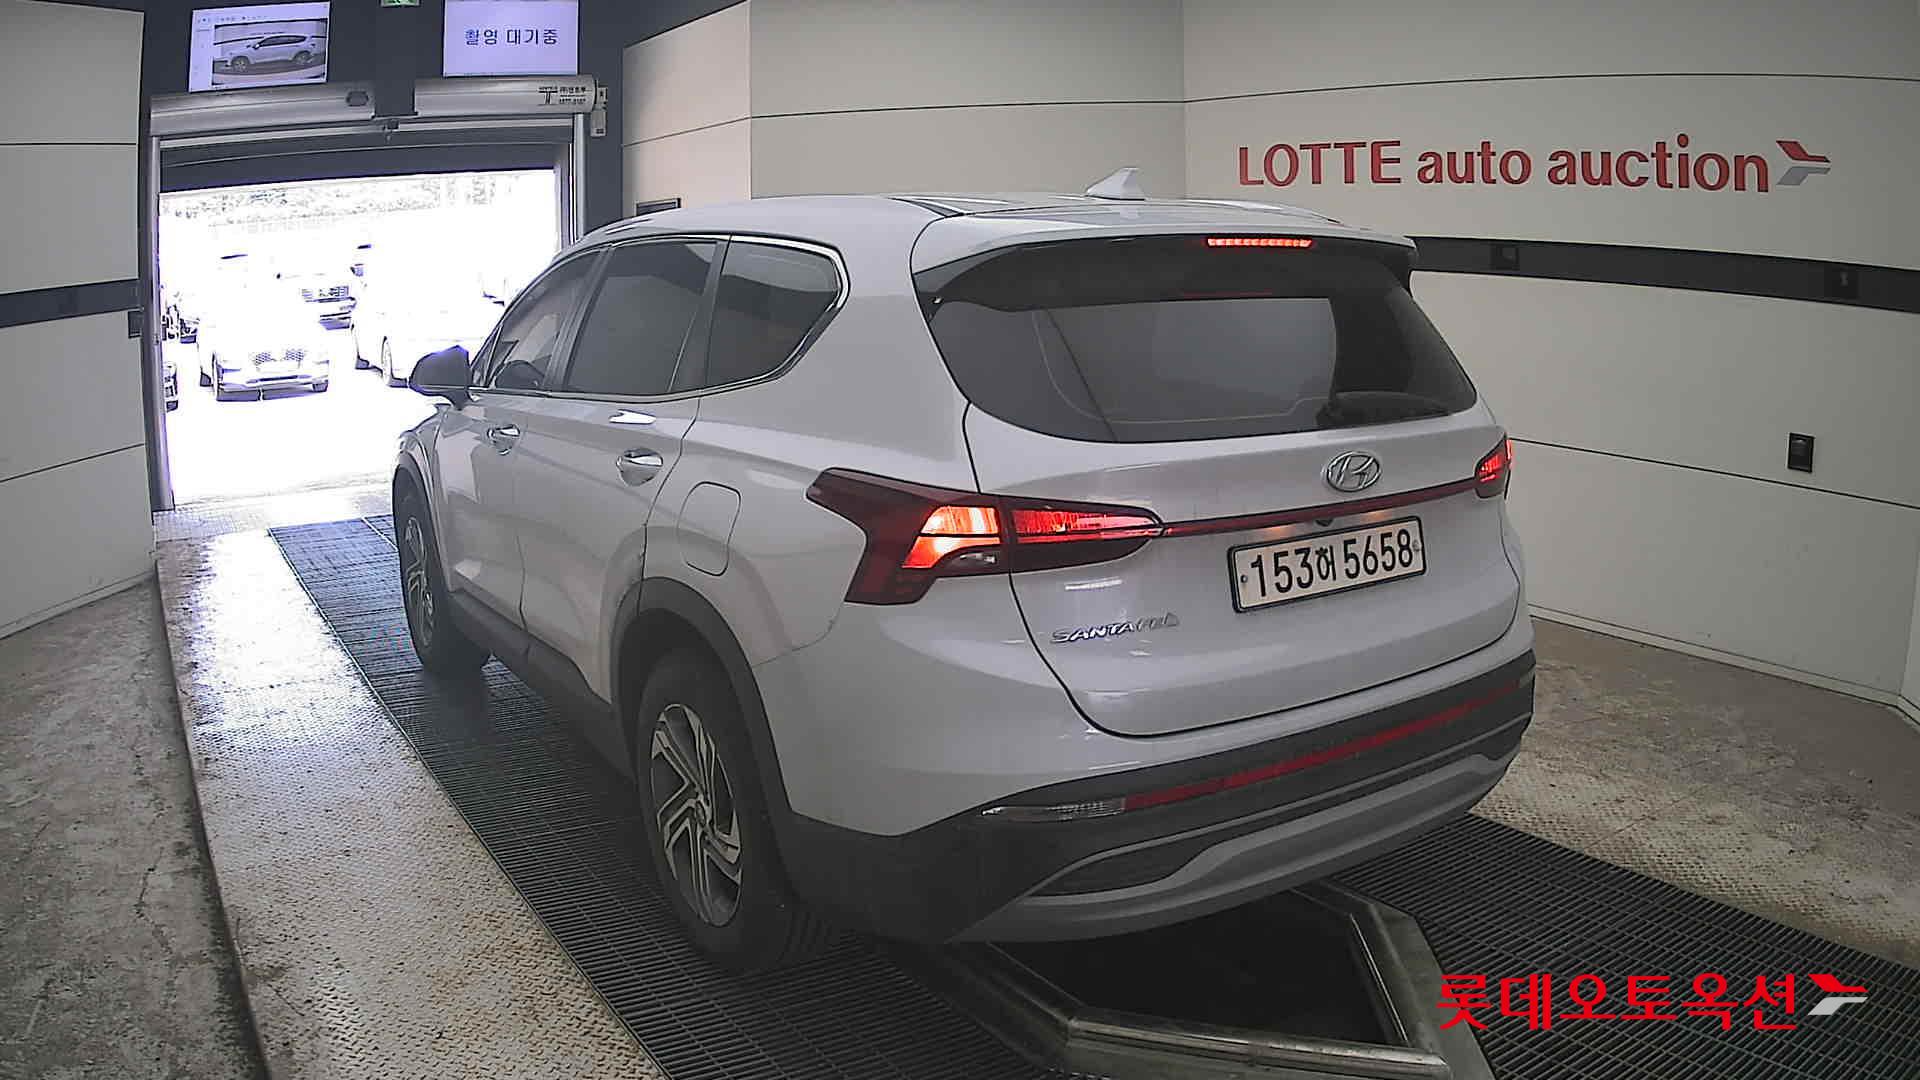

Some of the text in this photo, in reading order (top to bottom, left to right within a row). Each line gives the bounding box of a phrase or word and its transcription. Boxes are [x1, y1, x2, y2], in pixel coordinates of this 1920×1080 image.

[465, 28, 558, 46] 촬영 대기중
[1239, 133, 1769, 193] LOTTE auto auction
[1343, 528, 1413, 580] 5658
